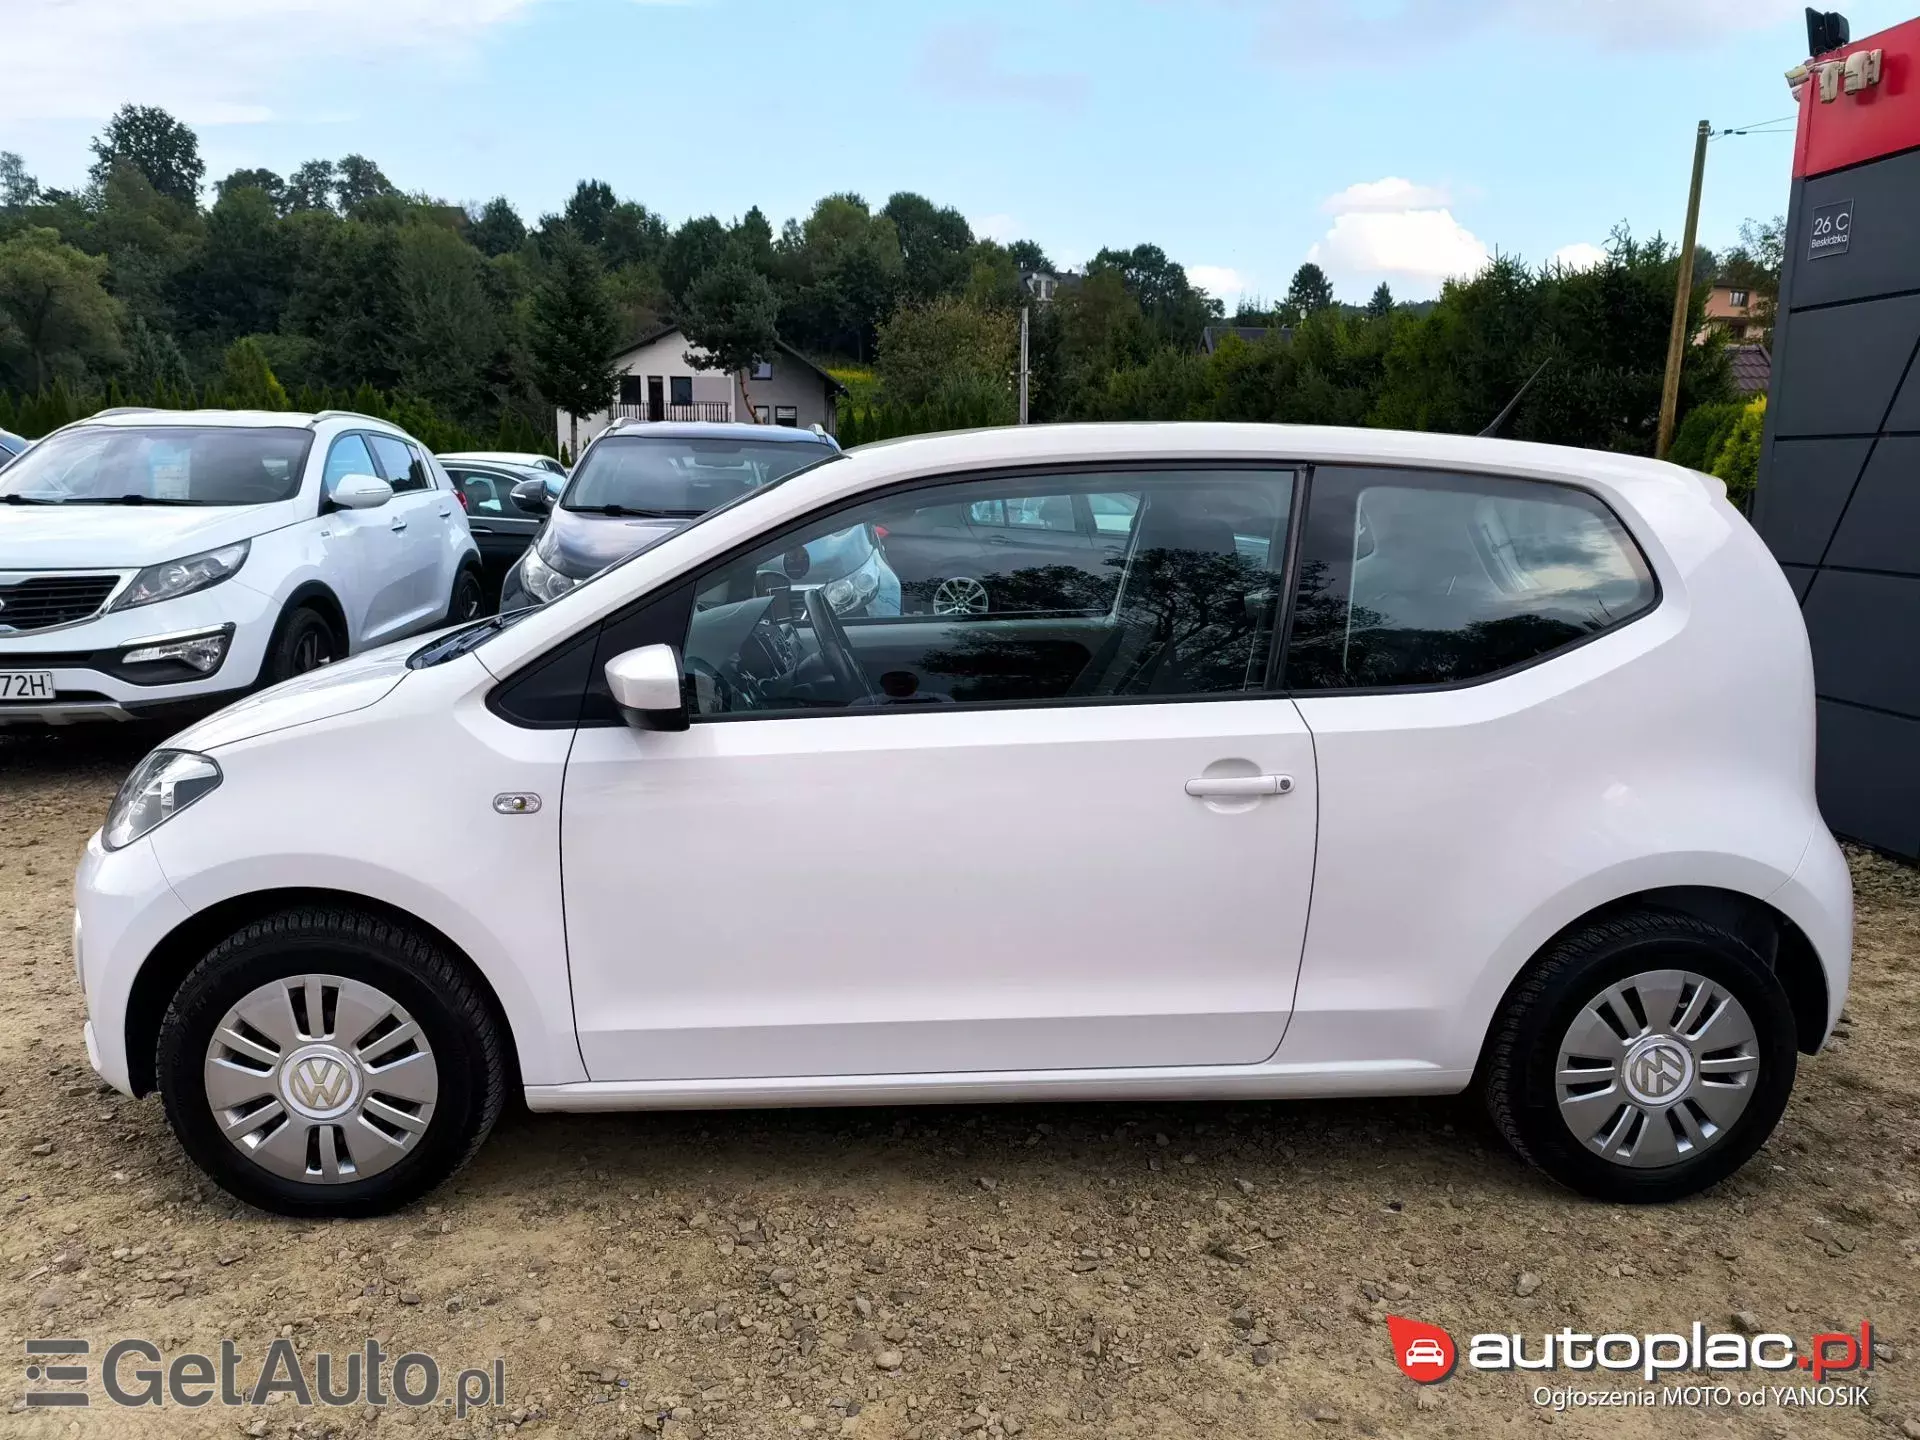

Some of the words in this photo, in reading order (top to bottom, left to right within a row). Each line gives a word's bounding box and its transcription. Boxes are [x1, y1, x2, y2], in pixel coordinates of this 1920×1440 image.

[1814, 216, 1831, 235] 26
[1836, 213, 1849, 230] C
[1811, 234, 1847, 248] Beskidzka
[0, 674, 46, 697] 72H
